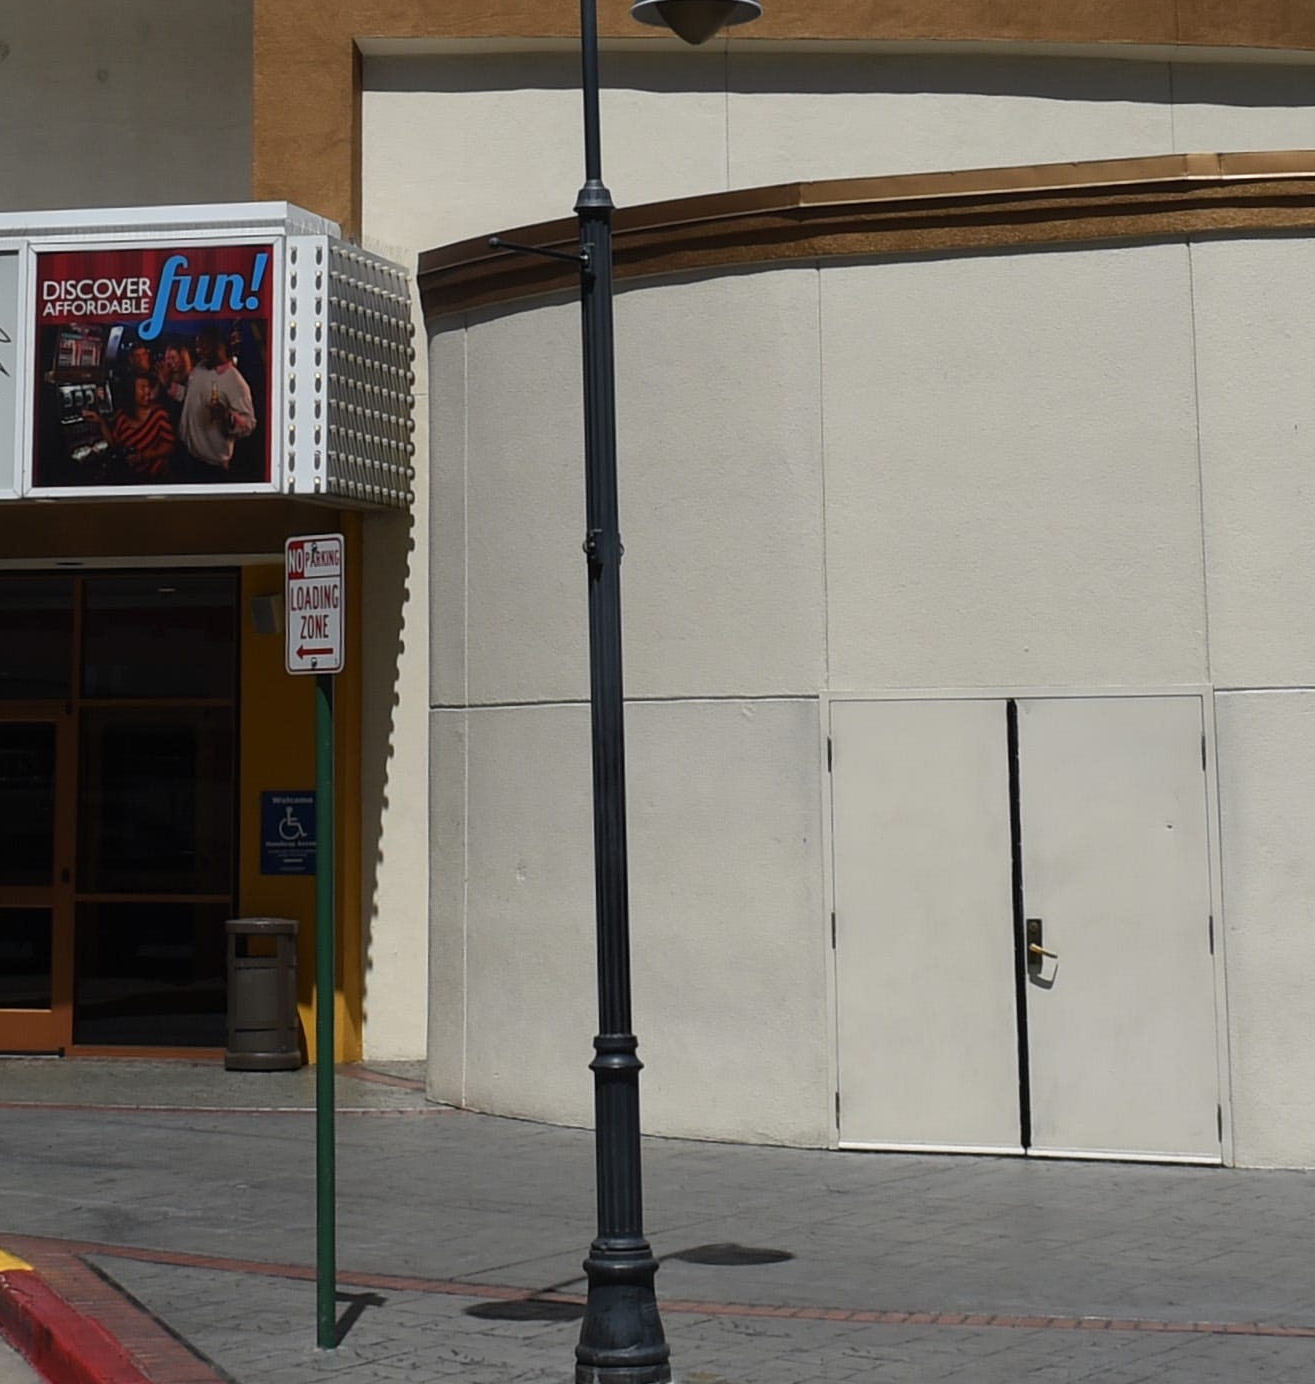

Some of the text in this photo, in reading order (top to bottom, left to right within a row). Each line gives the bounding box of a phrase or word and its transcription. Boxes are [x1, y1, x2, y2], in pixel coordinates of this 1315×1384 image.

[42, 277, 153, 301] DISCOVER
[137, 252, 269, 342] fun!
[42, 298, 151, 318] AFFORDABLE
[288, 548, 340, 574] NO PARKING
[290, 585, 339, 612] LOADING
[300, 614, 330, 640] ZONE
